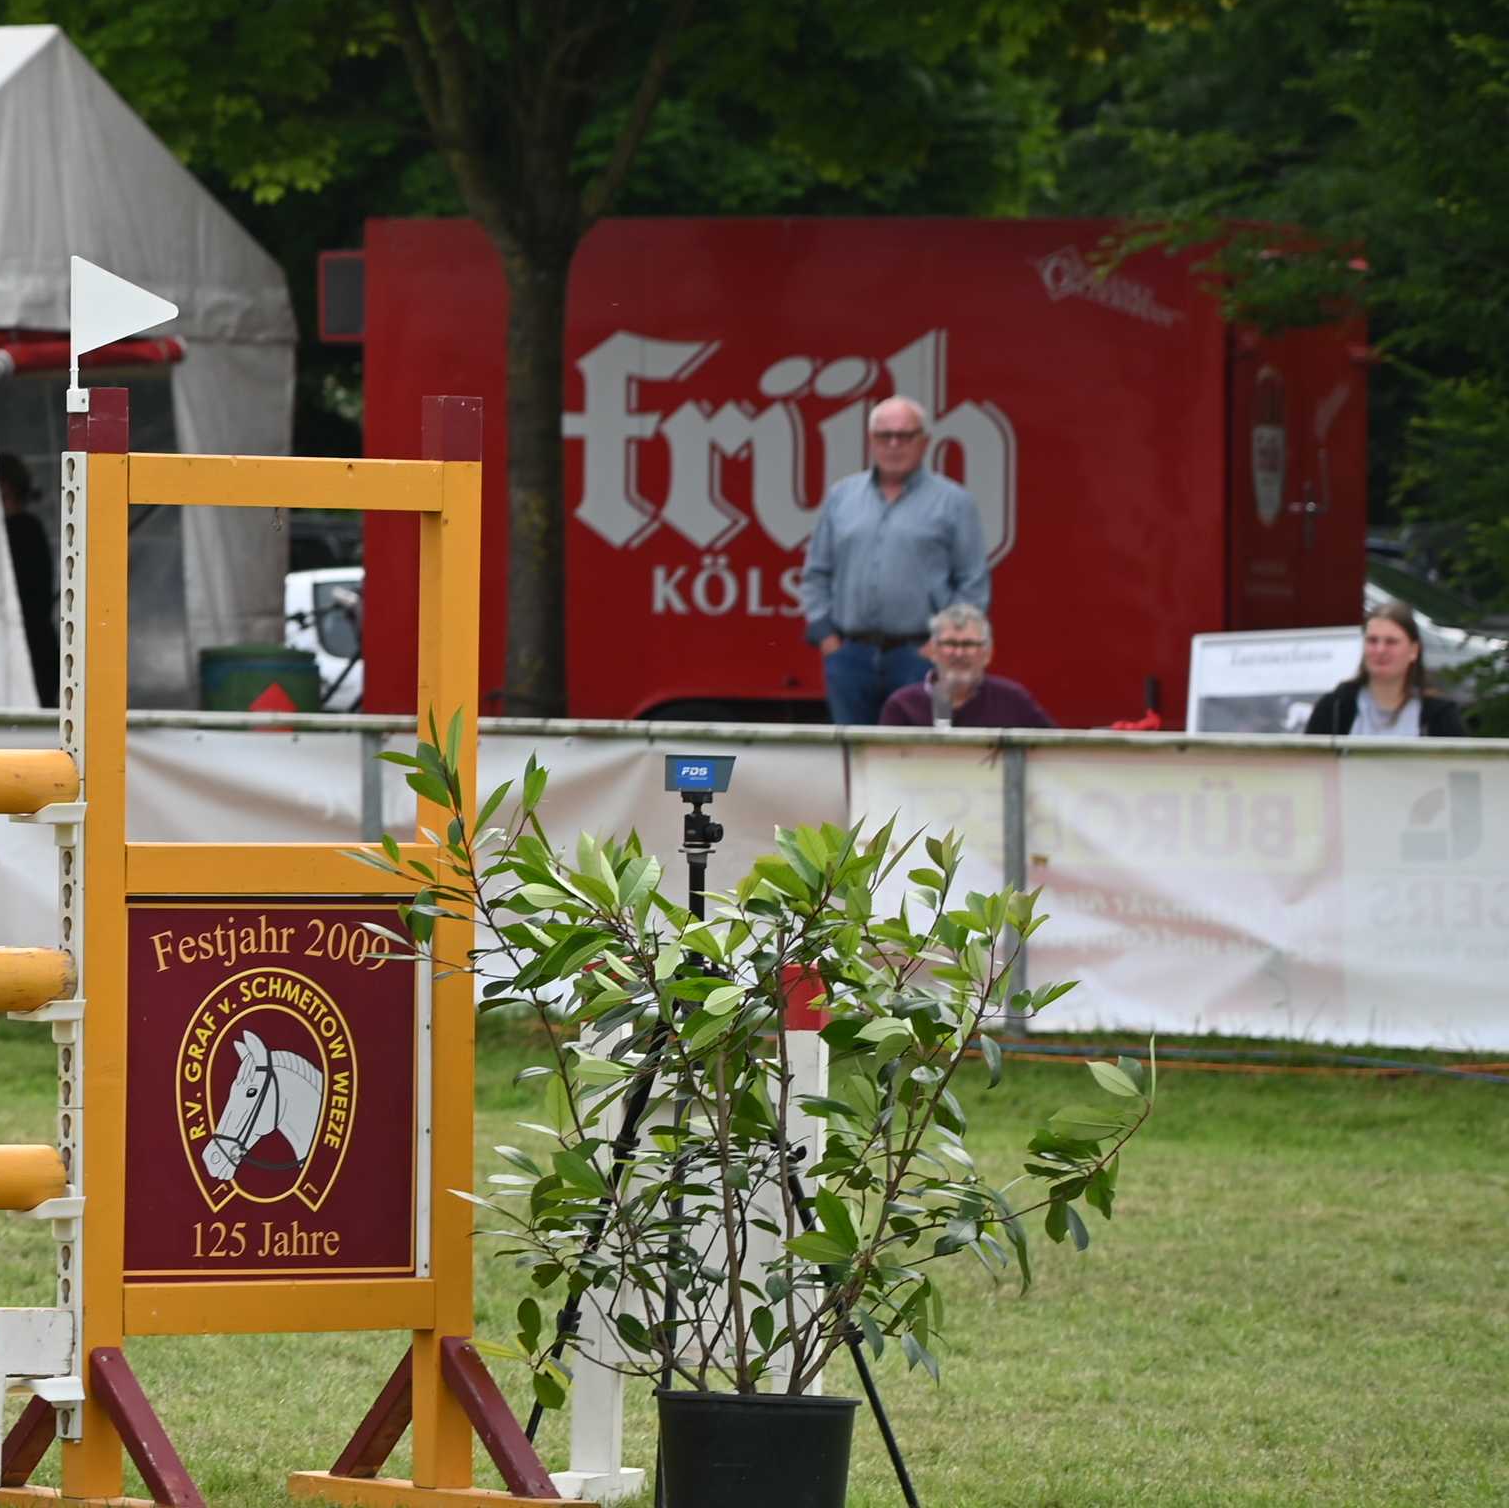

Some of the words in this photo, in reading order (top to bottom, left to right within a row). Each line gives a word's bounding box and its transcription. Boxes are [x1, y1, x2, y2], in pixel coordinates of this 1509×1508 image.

[652, 554, 807, 617] KÖLS
[681, 766, 709, 777] FDS
[149, 915, 295, 973] Festjahr
[304, 918, 390, 971] 2009
[184, 1012, 221, 1082] GRAF
[217, 999, 236, 1015] v.
[239, 975, 346, 1059] SCHMETTOW
[323, 1071, 350, 1149] WEEZE
[192, 1222, 246, 1258] 125
[257, 1220, 340, 1258] Jahre
